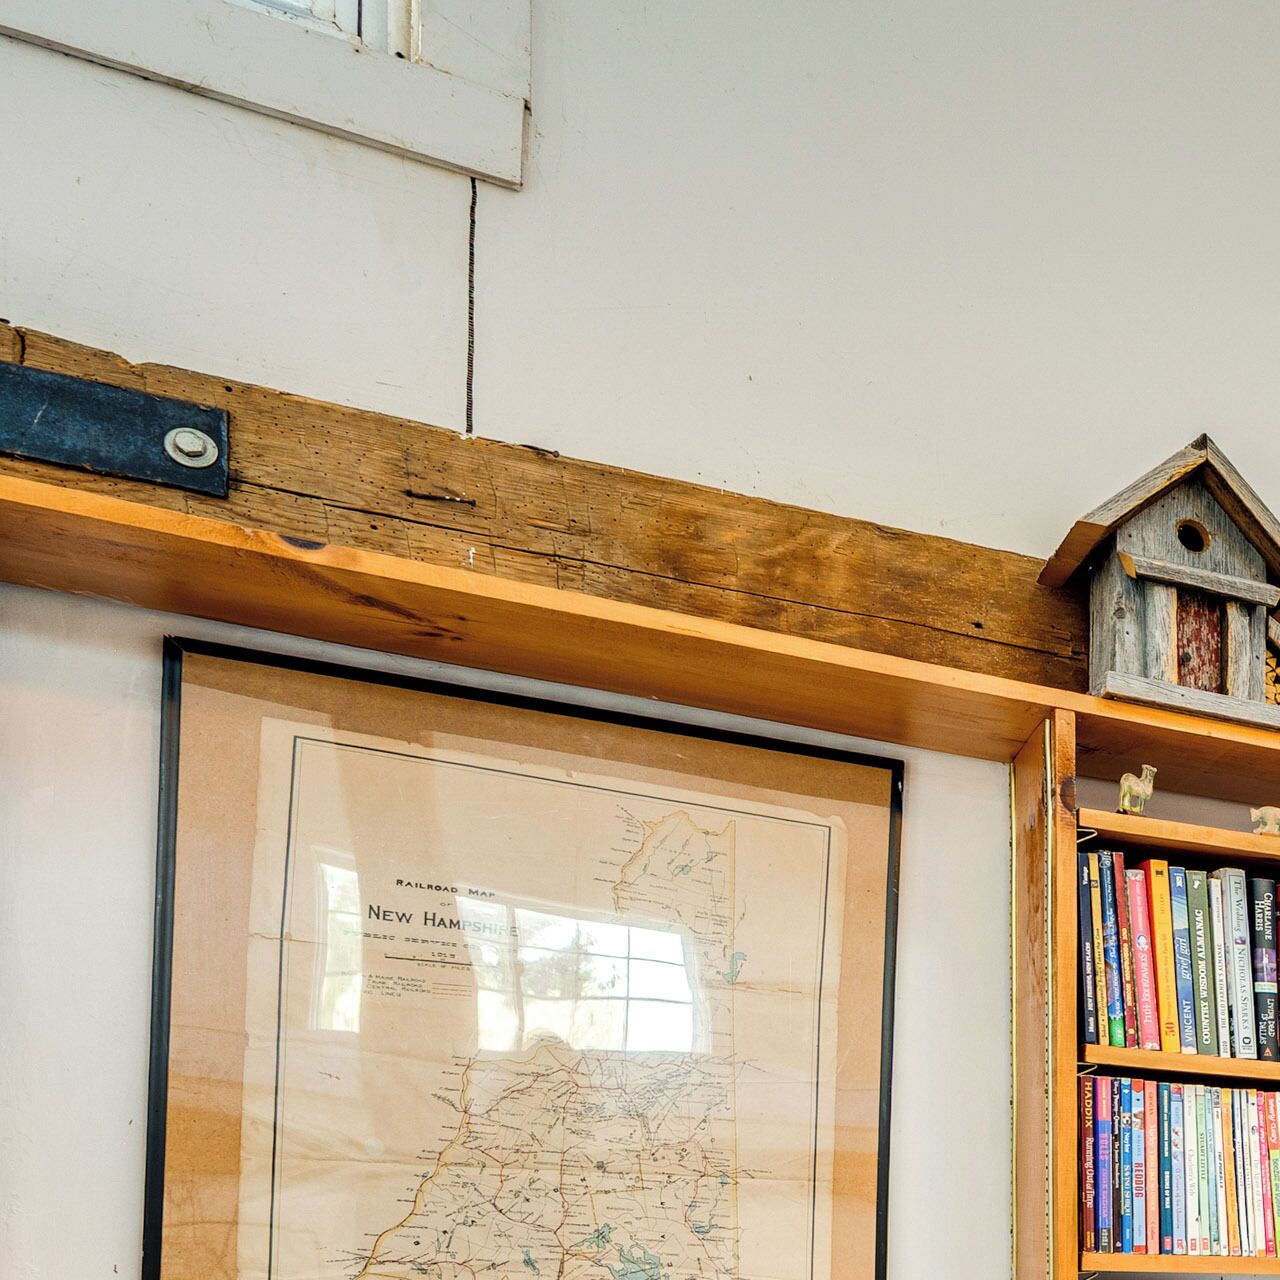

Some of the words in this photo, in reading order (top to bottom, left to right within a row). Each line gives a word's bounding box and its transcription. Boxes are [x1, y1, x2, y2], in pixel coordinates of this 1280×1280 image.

[396, 880, 458, 893] RAILROAD
[468, 888, 495, 897] MAP
[1234, 881, 1242, 895] The
[368, 905, 413, 923] NEW
[424, 912, 518, 937] HAMPSHIRE
[1235, 899, 1244, 932] Wedding
[1255, 900, 1264, 931] HARRIS
[1264, 892, 1272, 940] CHARLAINE
[1176, 937, 1188, 954] girl
[1195, 910, 1205, 958] ALMANAC
[1177, 956, 1190, 979] grief
[1198, 960, 1207, 998] WISDOM
[1238, 948, 1247, 993] NICHOLAS
[1183, 1000, 1193, 1042] VINCENT
[1200, 1001, 1210, 1044] COUNTRY
[1240, 996, 1249, 1030] SPARKS
[1165, 1022, 1175, 1036] 50
[1259, 1022, 1267, 1044] DALLAS
[1085, 1137, 1094, 1168] Running
[1086, 1169, 1094, 1183] Out
[1086, 1189, 1094, 1208] Time
